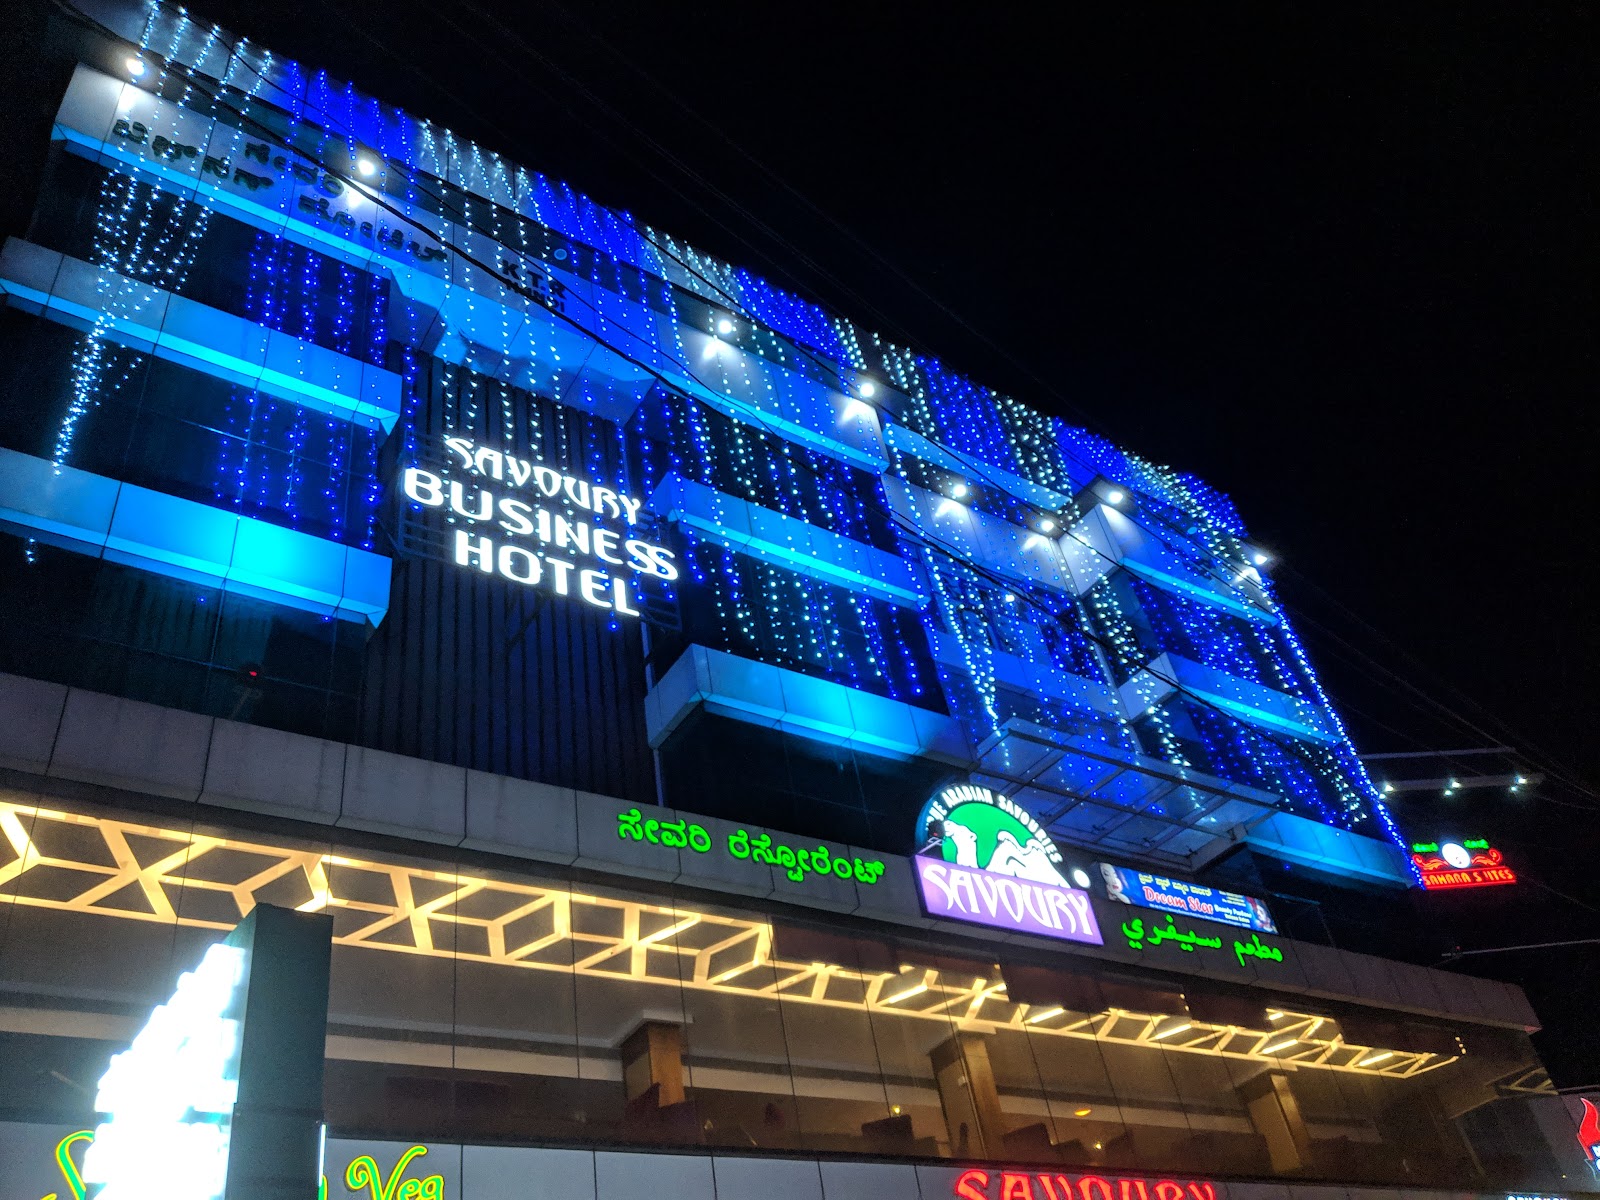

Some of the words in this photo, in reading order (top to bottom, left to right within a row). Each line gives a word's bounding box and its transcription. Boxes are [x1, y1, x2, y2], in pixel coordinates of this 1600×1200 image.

[444, 437, 641, 525] SAVOURY
[404, 467, 679, 581] BUSINESS
[455, 529, 640, 616] HOTEL
[617, 808, 712, 852] ಸೇವರಿ
[941, 785, 993, 808] ARABIAN
[998, 794, 1064, 863] SAVOURIES
[922, 864, 1094, 936] SAVOURY
[1142, 886, 1188, 911] Dream
[1187, 896, 1214, 915] Star
[1421, 872, 1472, 886] SAHARA
[1122, 914, 1223, 952] سيفري
[1233, 933, 1284, 967] مطعم
